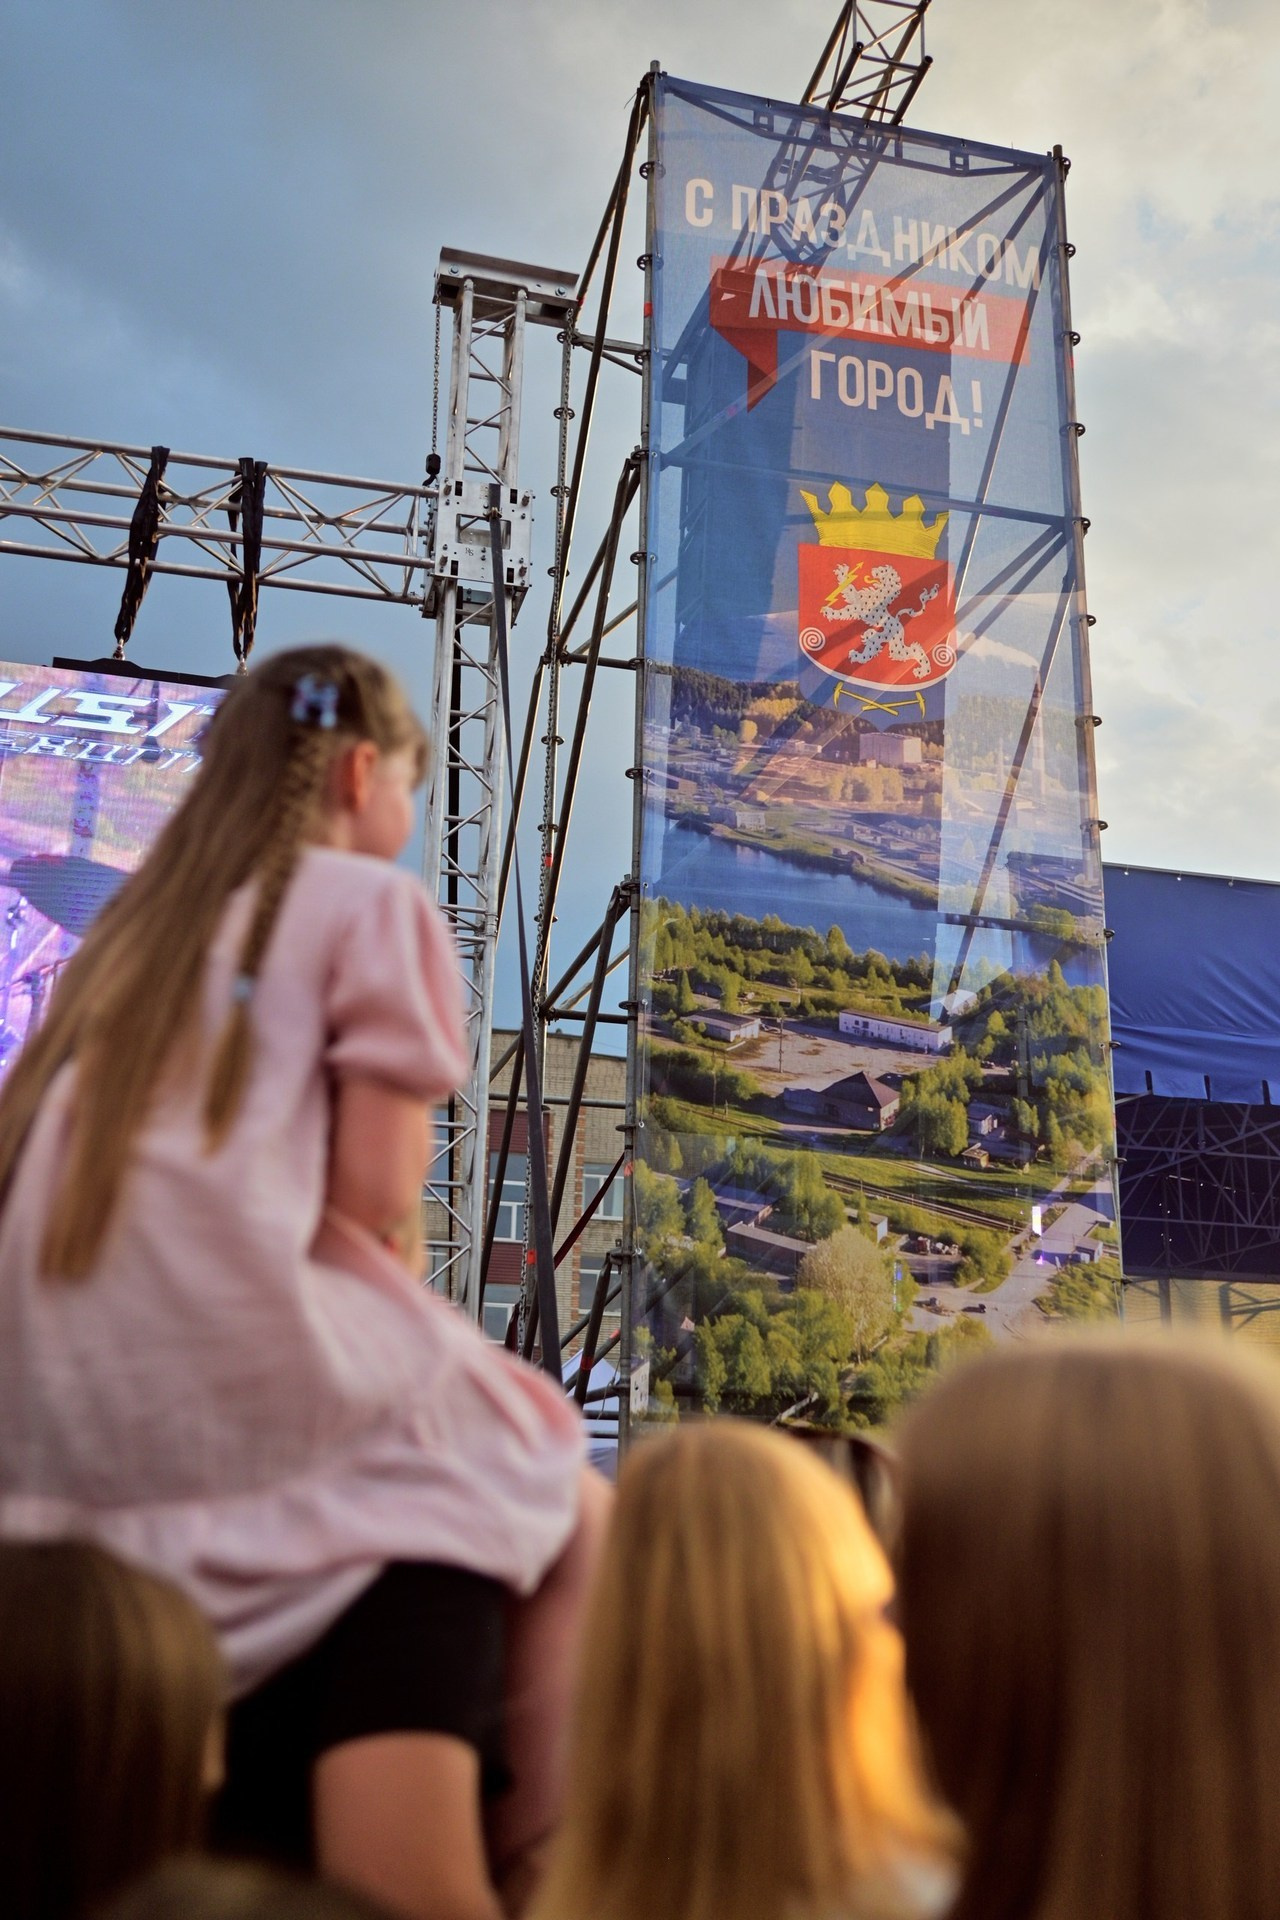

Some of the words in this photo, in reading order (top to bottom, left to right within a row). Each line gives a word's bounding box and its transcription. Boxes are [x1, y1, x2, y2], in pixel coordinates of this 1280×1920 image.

[685, 178, 714, 228] С
[731, 184, 1041, 291] ПРАЗДНИКОМ
[748, 269, 991, 351] ЛЮБИМЫЙ
[810, 349, 985, 435] ГОРОД!
